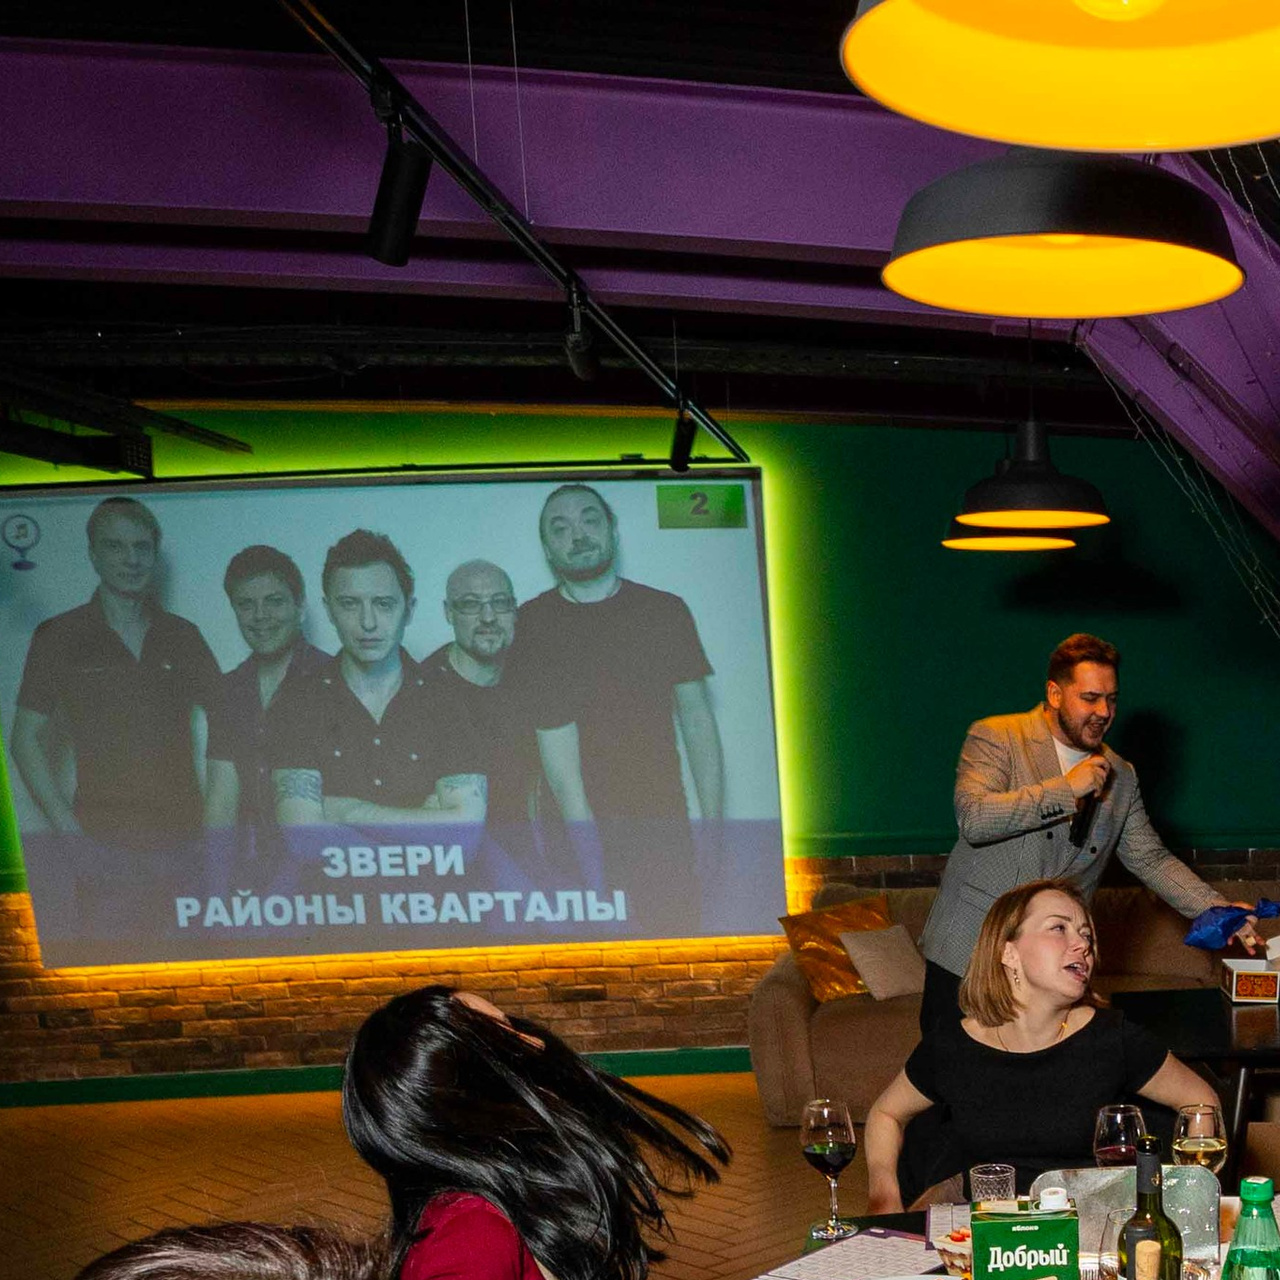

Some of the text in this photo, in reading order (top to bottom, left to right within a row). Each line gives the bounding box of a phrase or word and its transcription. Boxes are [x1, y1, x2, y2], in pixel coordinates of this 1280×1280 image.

[689, 492, 709, 517] 2
[322, 845, 466, 879] ЗВЕРИ
[176, 888, 627, 928] РАЙОНЫ КВАРТАЛЫ
[988, 1243, 1068, 1273] Добрый
